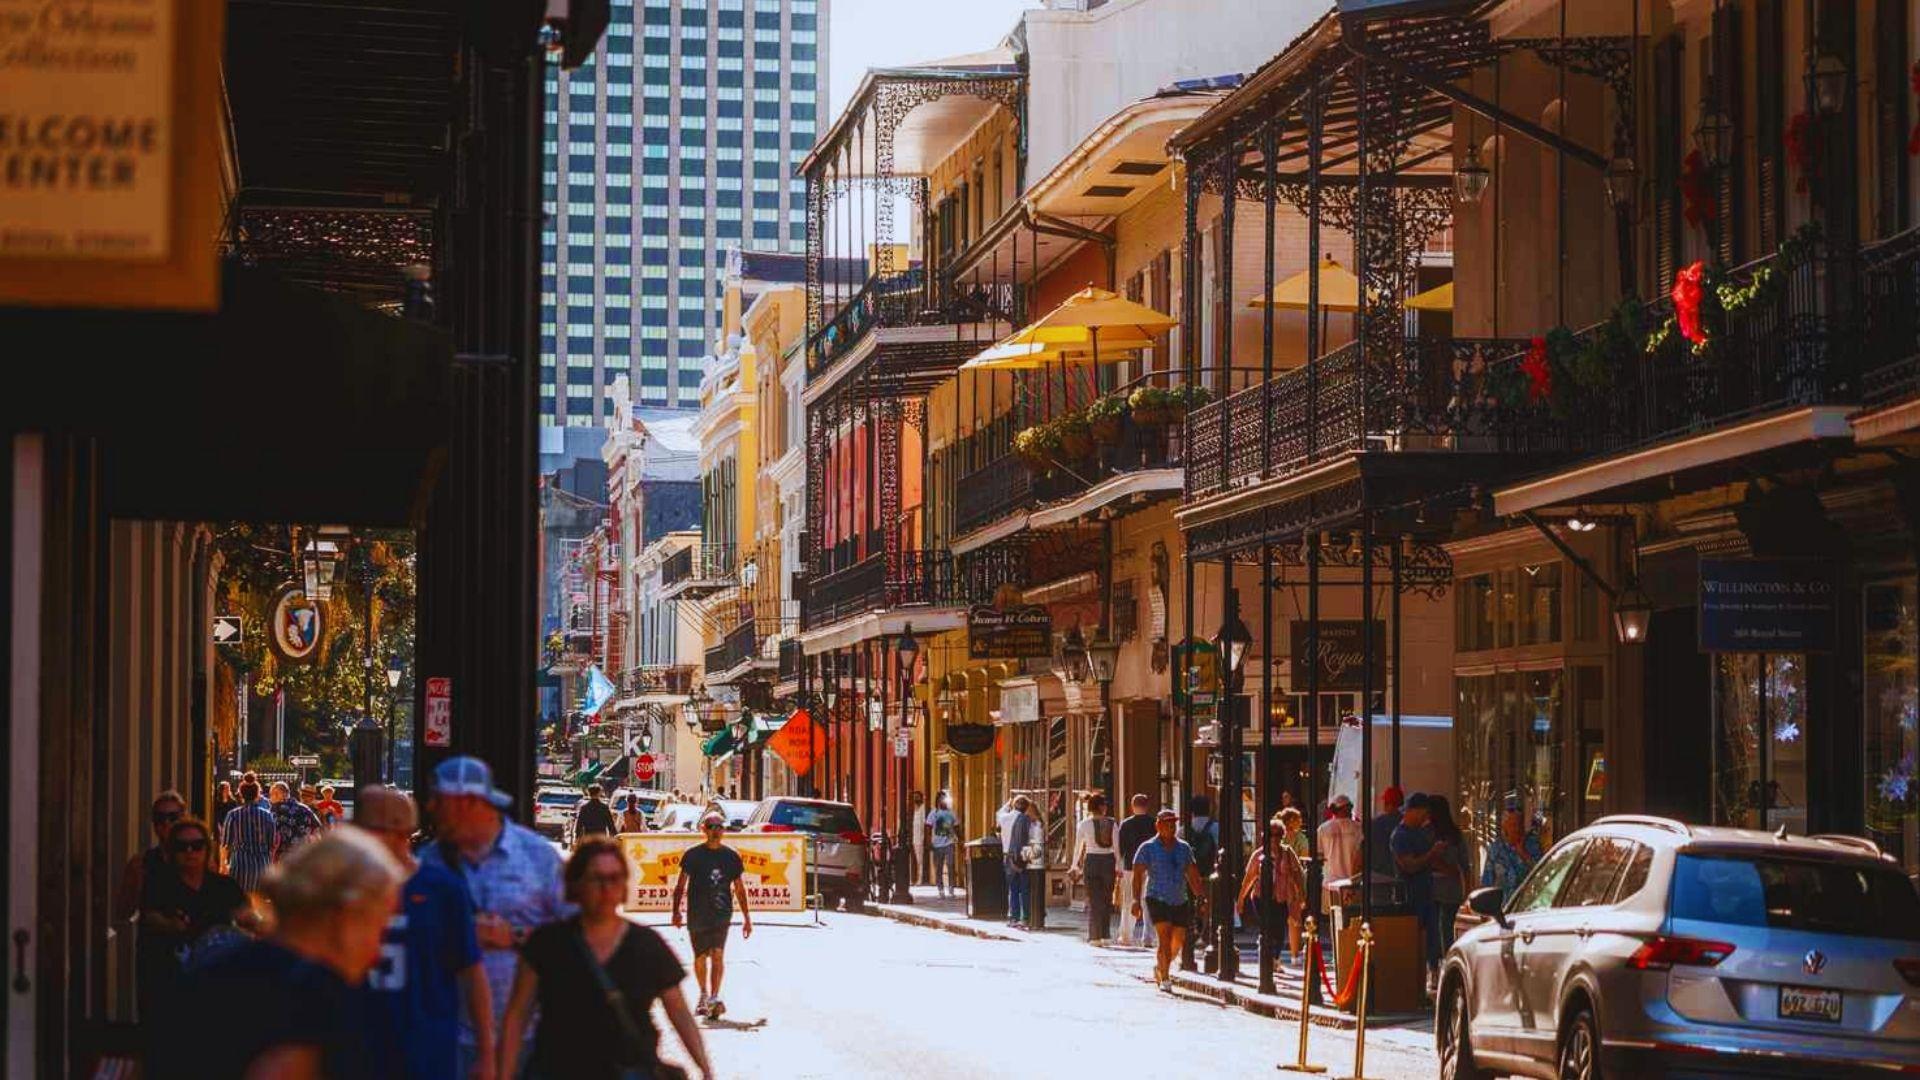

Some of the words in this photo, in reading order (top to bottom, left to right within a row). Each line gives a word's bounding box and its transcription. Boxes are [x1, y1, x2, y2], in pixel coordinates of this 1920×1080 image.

[1703, 580, 1790, 593] WELLINGTON
[1793, 582, 1806, 593] &
[748, 887, 790, 897] MALL
